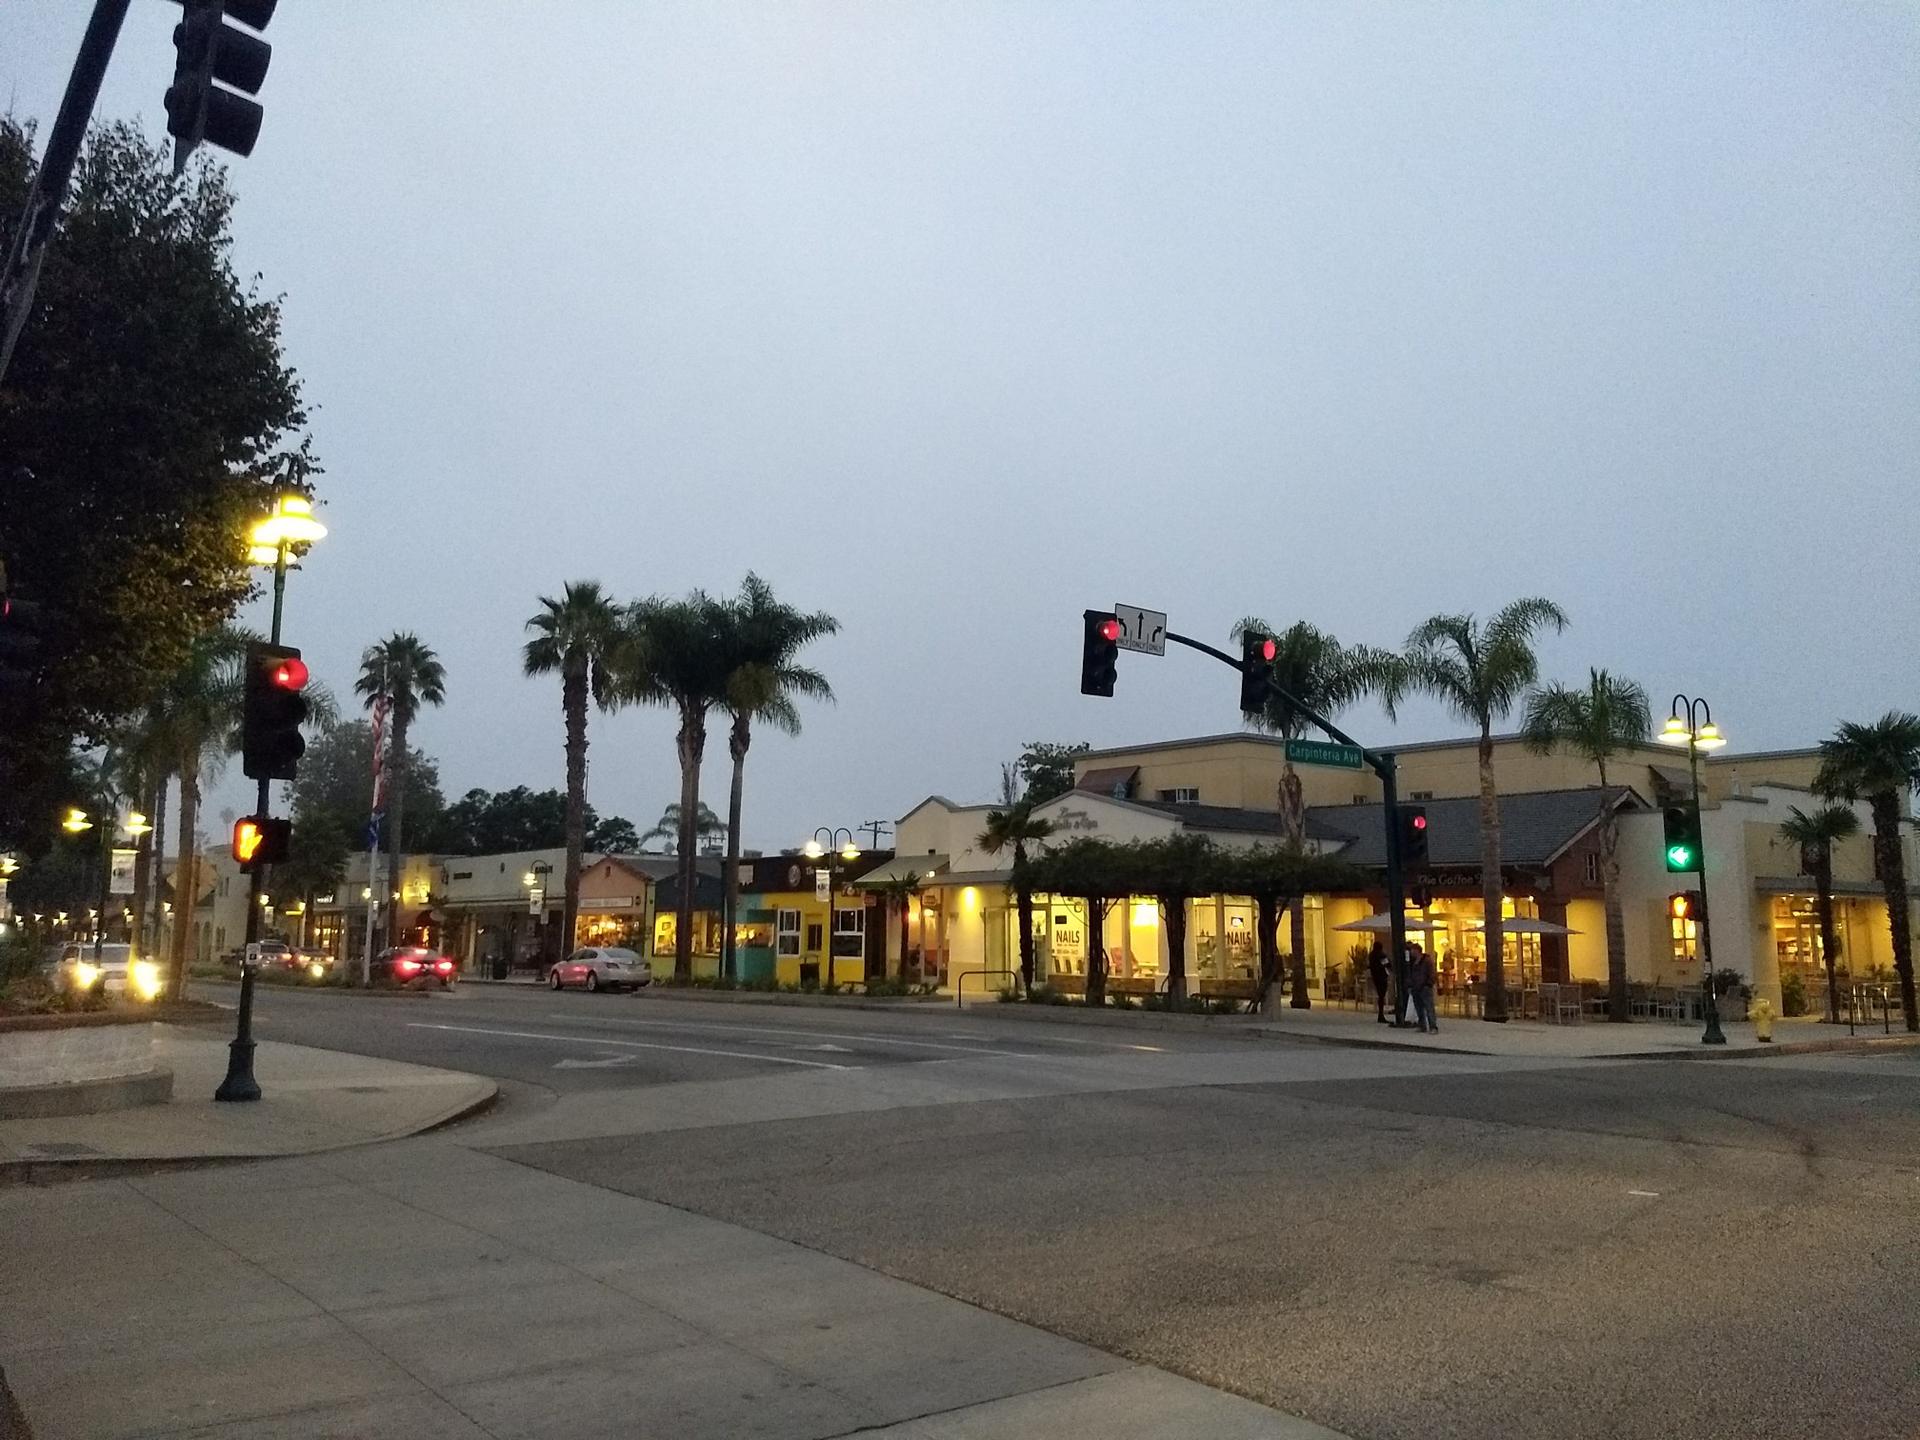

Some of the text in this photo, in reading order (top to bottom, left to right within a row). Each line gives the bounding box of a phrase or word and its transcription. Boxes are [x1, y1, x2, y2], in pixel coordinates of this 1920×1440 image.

[1131, 640, 1146, 649] ONLY
[1148, 643, 1163, 652] ONLY
[1289, 743, 1359, 764] Carpinteria Ave
[1438, 873, 1474, 887] Coffee
[1056, 930, 1080, 944] NAILS
[1227, 931, 1251, 945] NAILS
